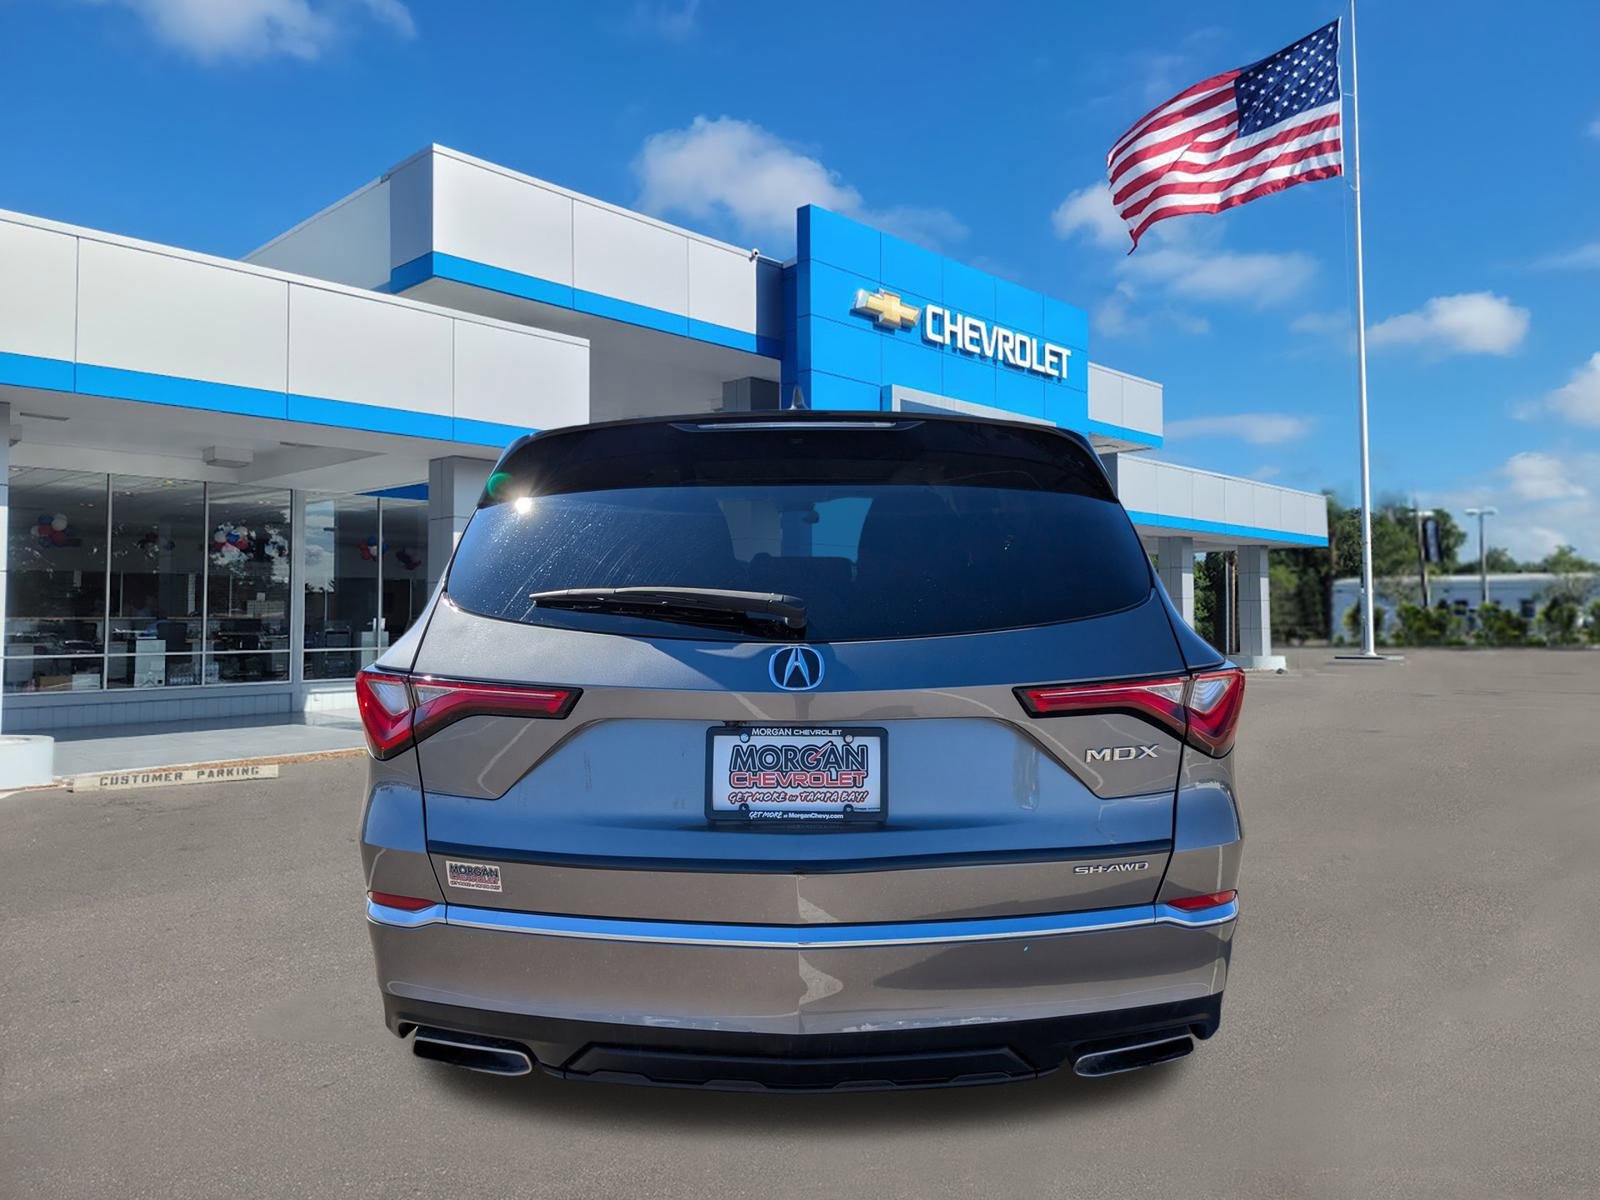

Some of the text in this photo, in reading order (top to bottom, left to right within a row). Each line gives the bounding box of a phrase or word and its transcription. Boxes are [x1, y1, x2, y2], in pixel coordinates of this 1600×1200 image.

[925, 304, 1072, 379] CHEVROLET
[751, 728, 792, 736] MORGAN
[730, 741, 868, 771] MORGAN
[1085, 744, 1159, 763] MDX
[99, 766, 260, 787] CUSTOMER PARKING
[730, 771, 868, 788] CHEVROLET
[728, 792, 751, 804] GET
[752, 792, 786, 802] MORE
[800, 792, 840, 803] TAMPA
[841, 791, 869, 803] BAY!
[749, 811, 763, 819] GET
[788, 812, 844, 820] MorganChevy.com
[449, 863, 499, 877] MORGAN
